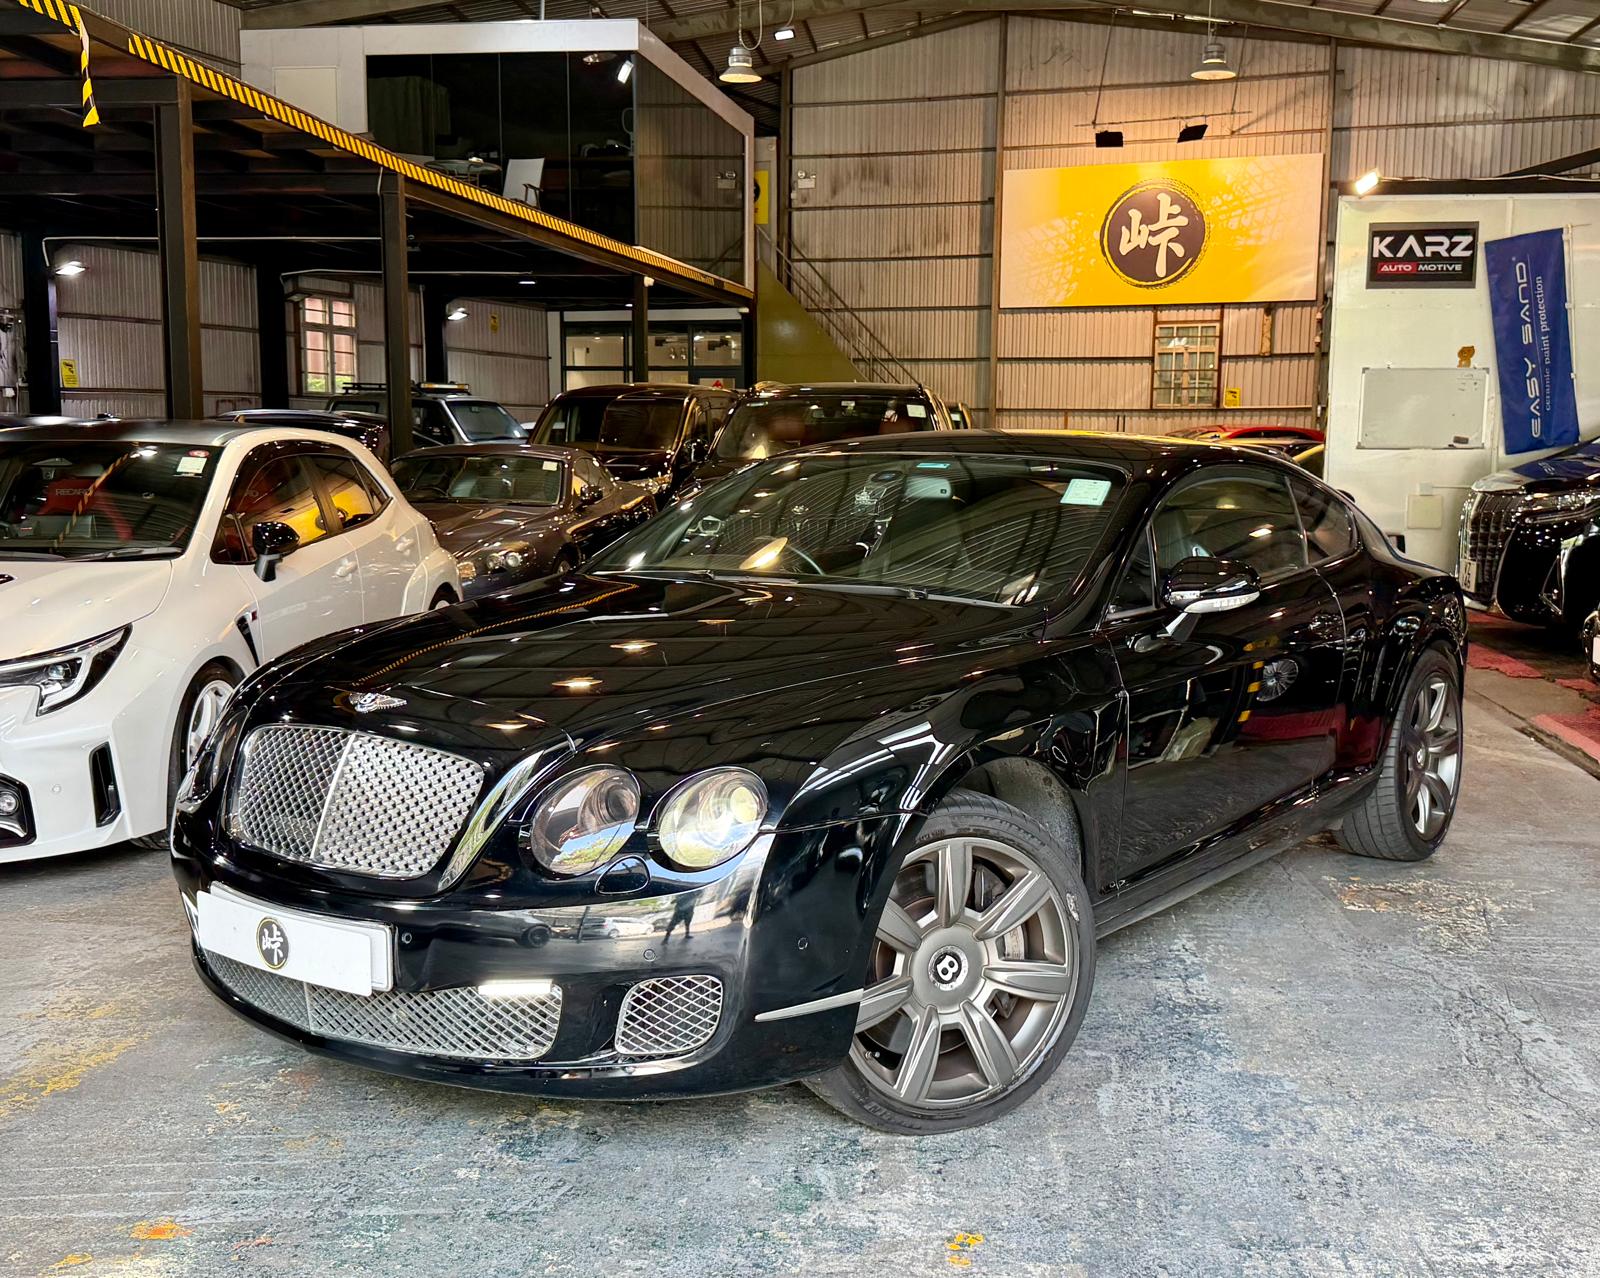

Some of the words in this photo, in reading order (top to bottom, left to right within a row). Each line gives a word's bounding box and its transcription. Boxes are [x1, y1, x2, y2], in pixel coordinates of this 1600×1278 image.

[1118, 192, 1188, 278] 峠
[1372, 235, 1474, 258] KARZ
[1380, 264, 1412, 272] AUTO
[1417, 263, 1462, 272] MOTIVE
[1515, 262, 1533, 345] SAND
[1534, 275, 1550, 332] protection
[1540, 335, 1551, 365] paint
[1524, 357, 1541, 438] EASY
[262, 923, 284, 966] 峠
[936, 954, 959, 982] B
